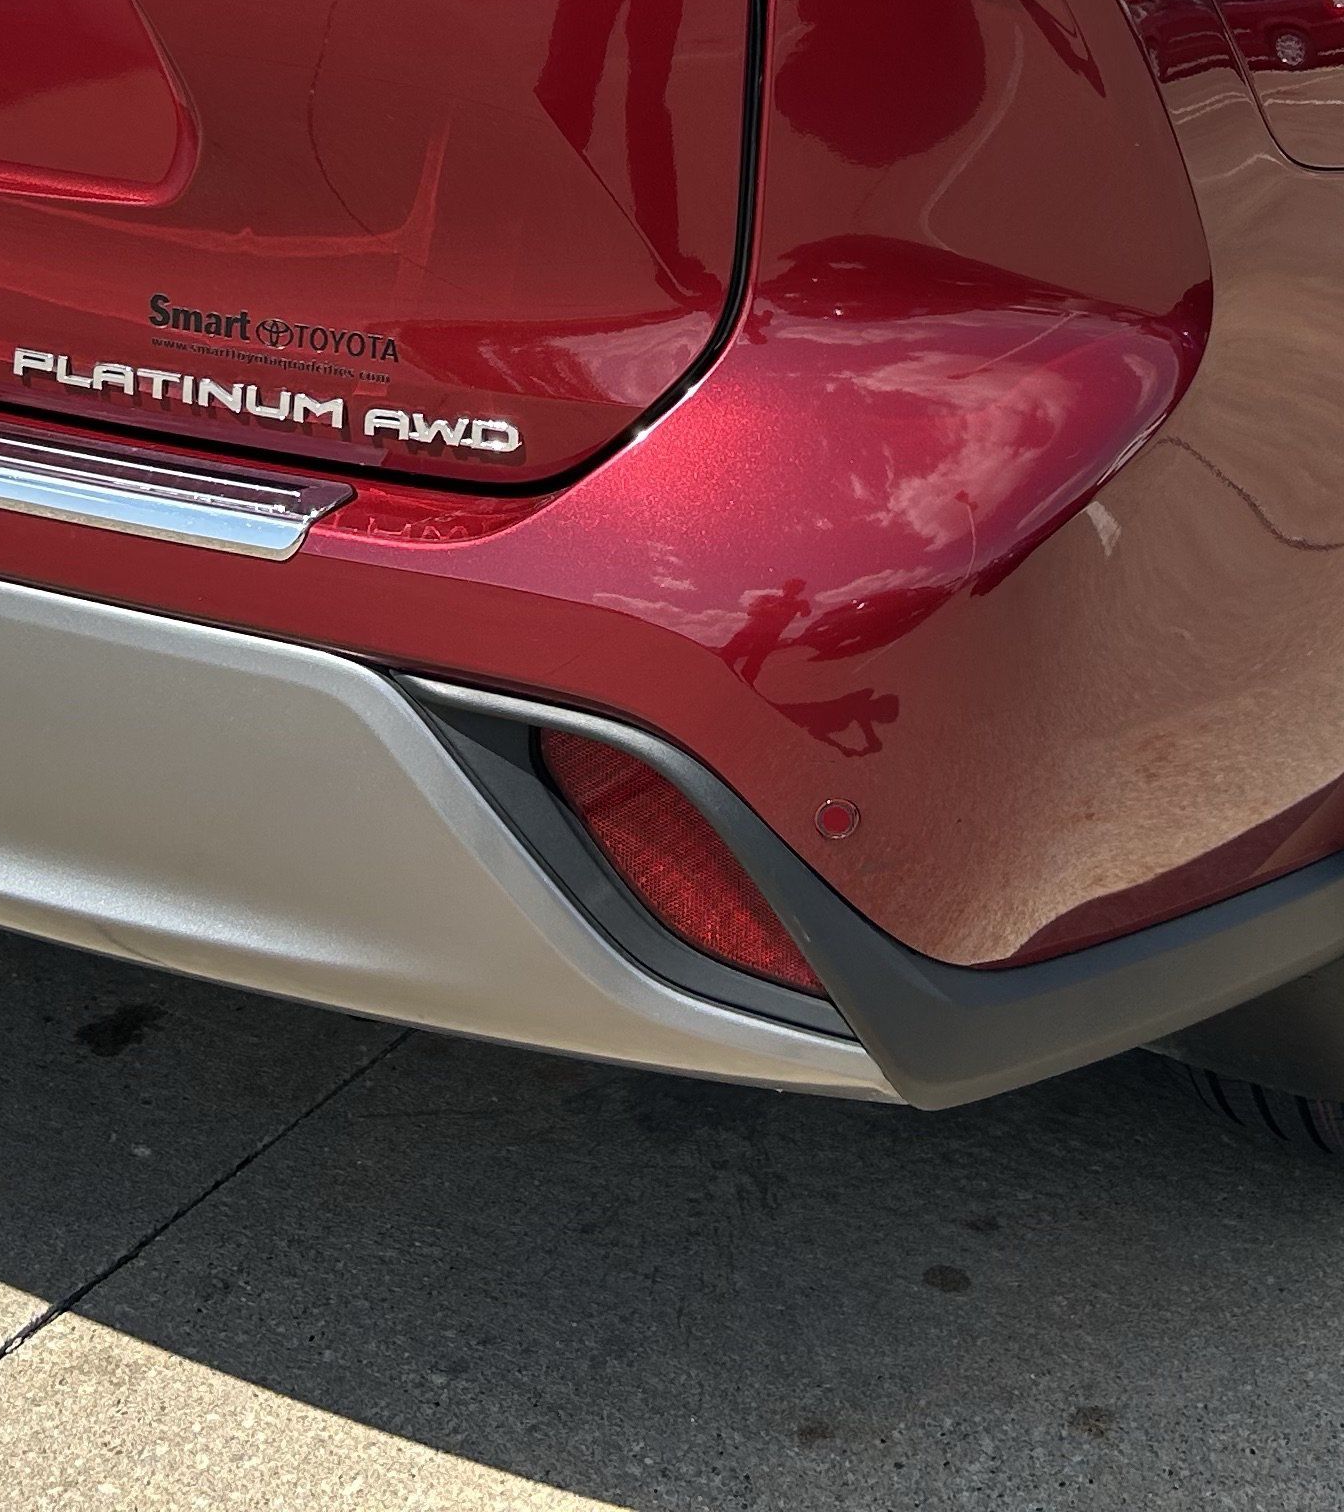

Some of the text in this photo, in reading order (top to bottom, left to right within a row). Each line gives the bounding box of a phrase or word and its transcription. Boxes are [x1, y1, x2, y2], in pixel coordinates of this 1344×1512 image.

[148, 292, 400, 364] Smart TOYOTA
[13, 346, 522, 453] PLATINUM AWD
